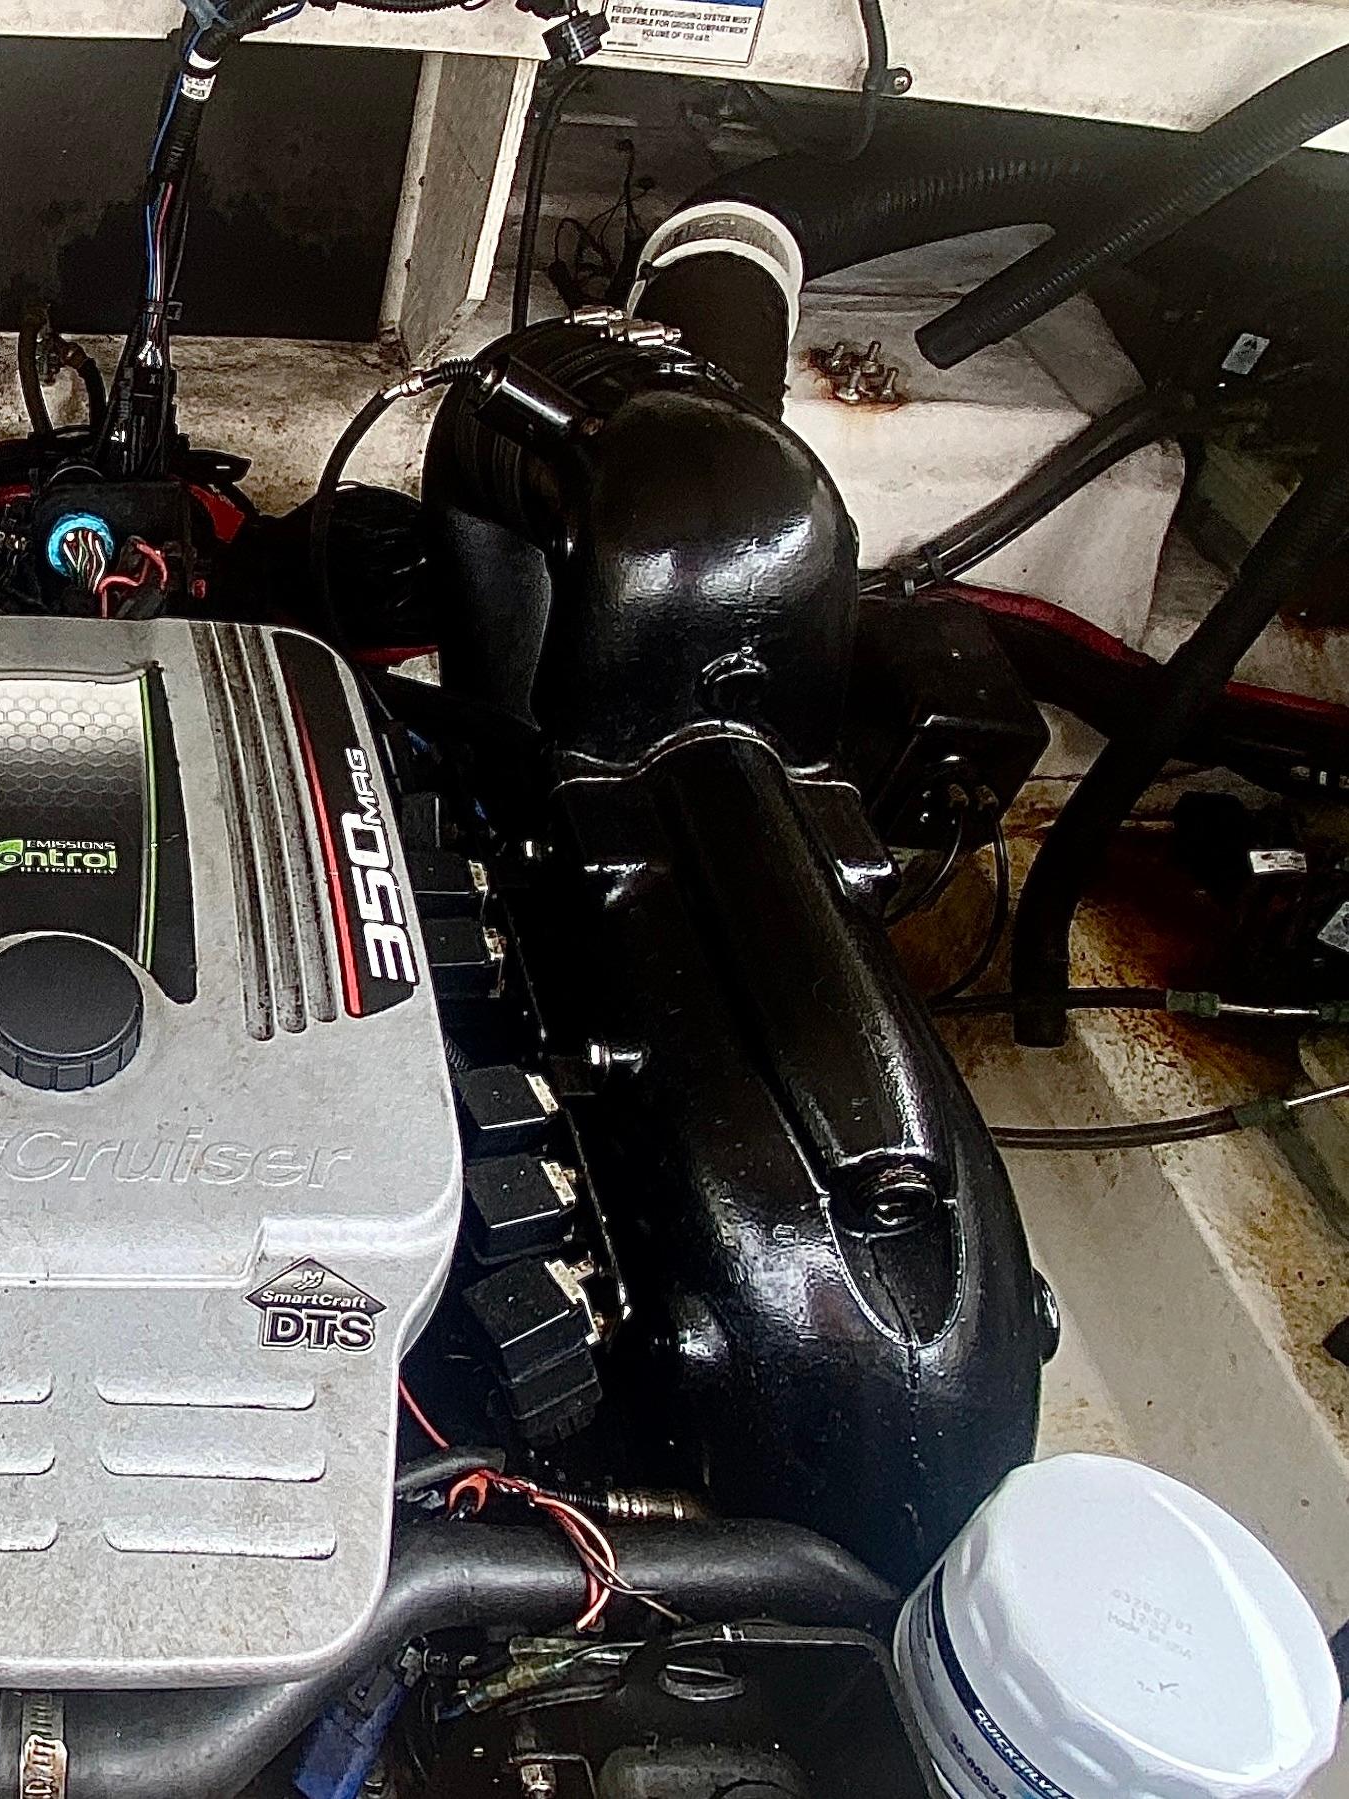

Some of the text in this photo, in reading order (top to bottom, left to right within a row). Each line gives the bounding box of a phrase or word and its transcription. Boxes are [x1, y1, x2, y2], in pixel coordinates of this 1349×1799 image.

[610, 15, 749, 35] BE SUITABLE FOR GROSS COMPARTMENT
[611, 5, 752, 25] FIXED FIRE EXTINGUISHING SYSTEM MUST
[642, 29, 671, 39] VOLUME
[671, 30, 682, 41] OF
[26, 839, 117, 850] EMISSIONS
[341, 747, 419, 984] 350 MAG
[261, 1289, 368, 1309] SmartCraft
[263, 1307, 375, 1351] DTS
